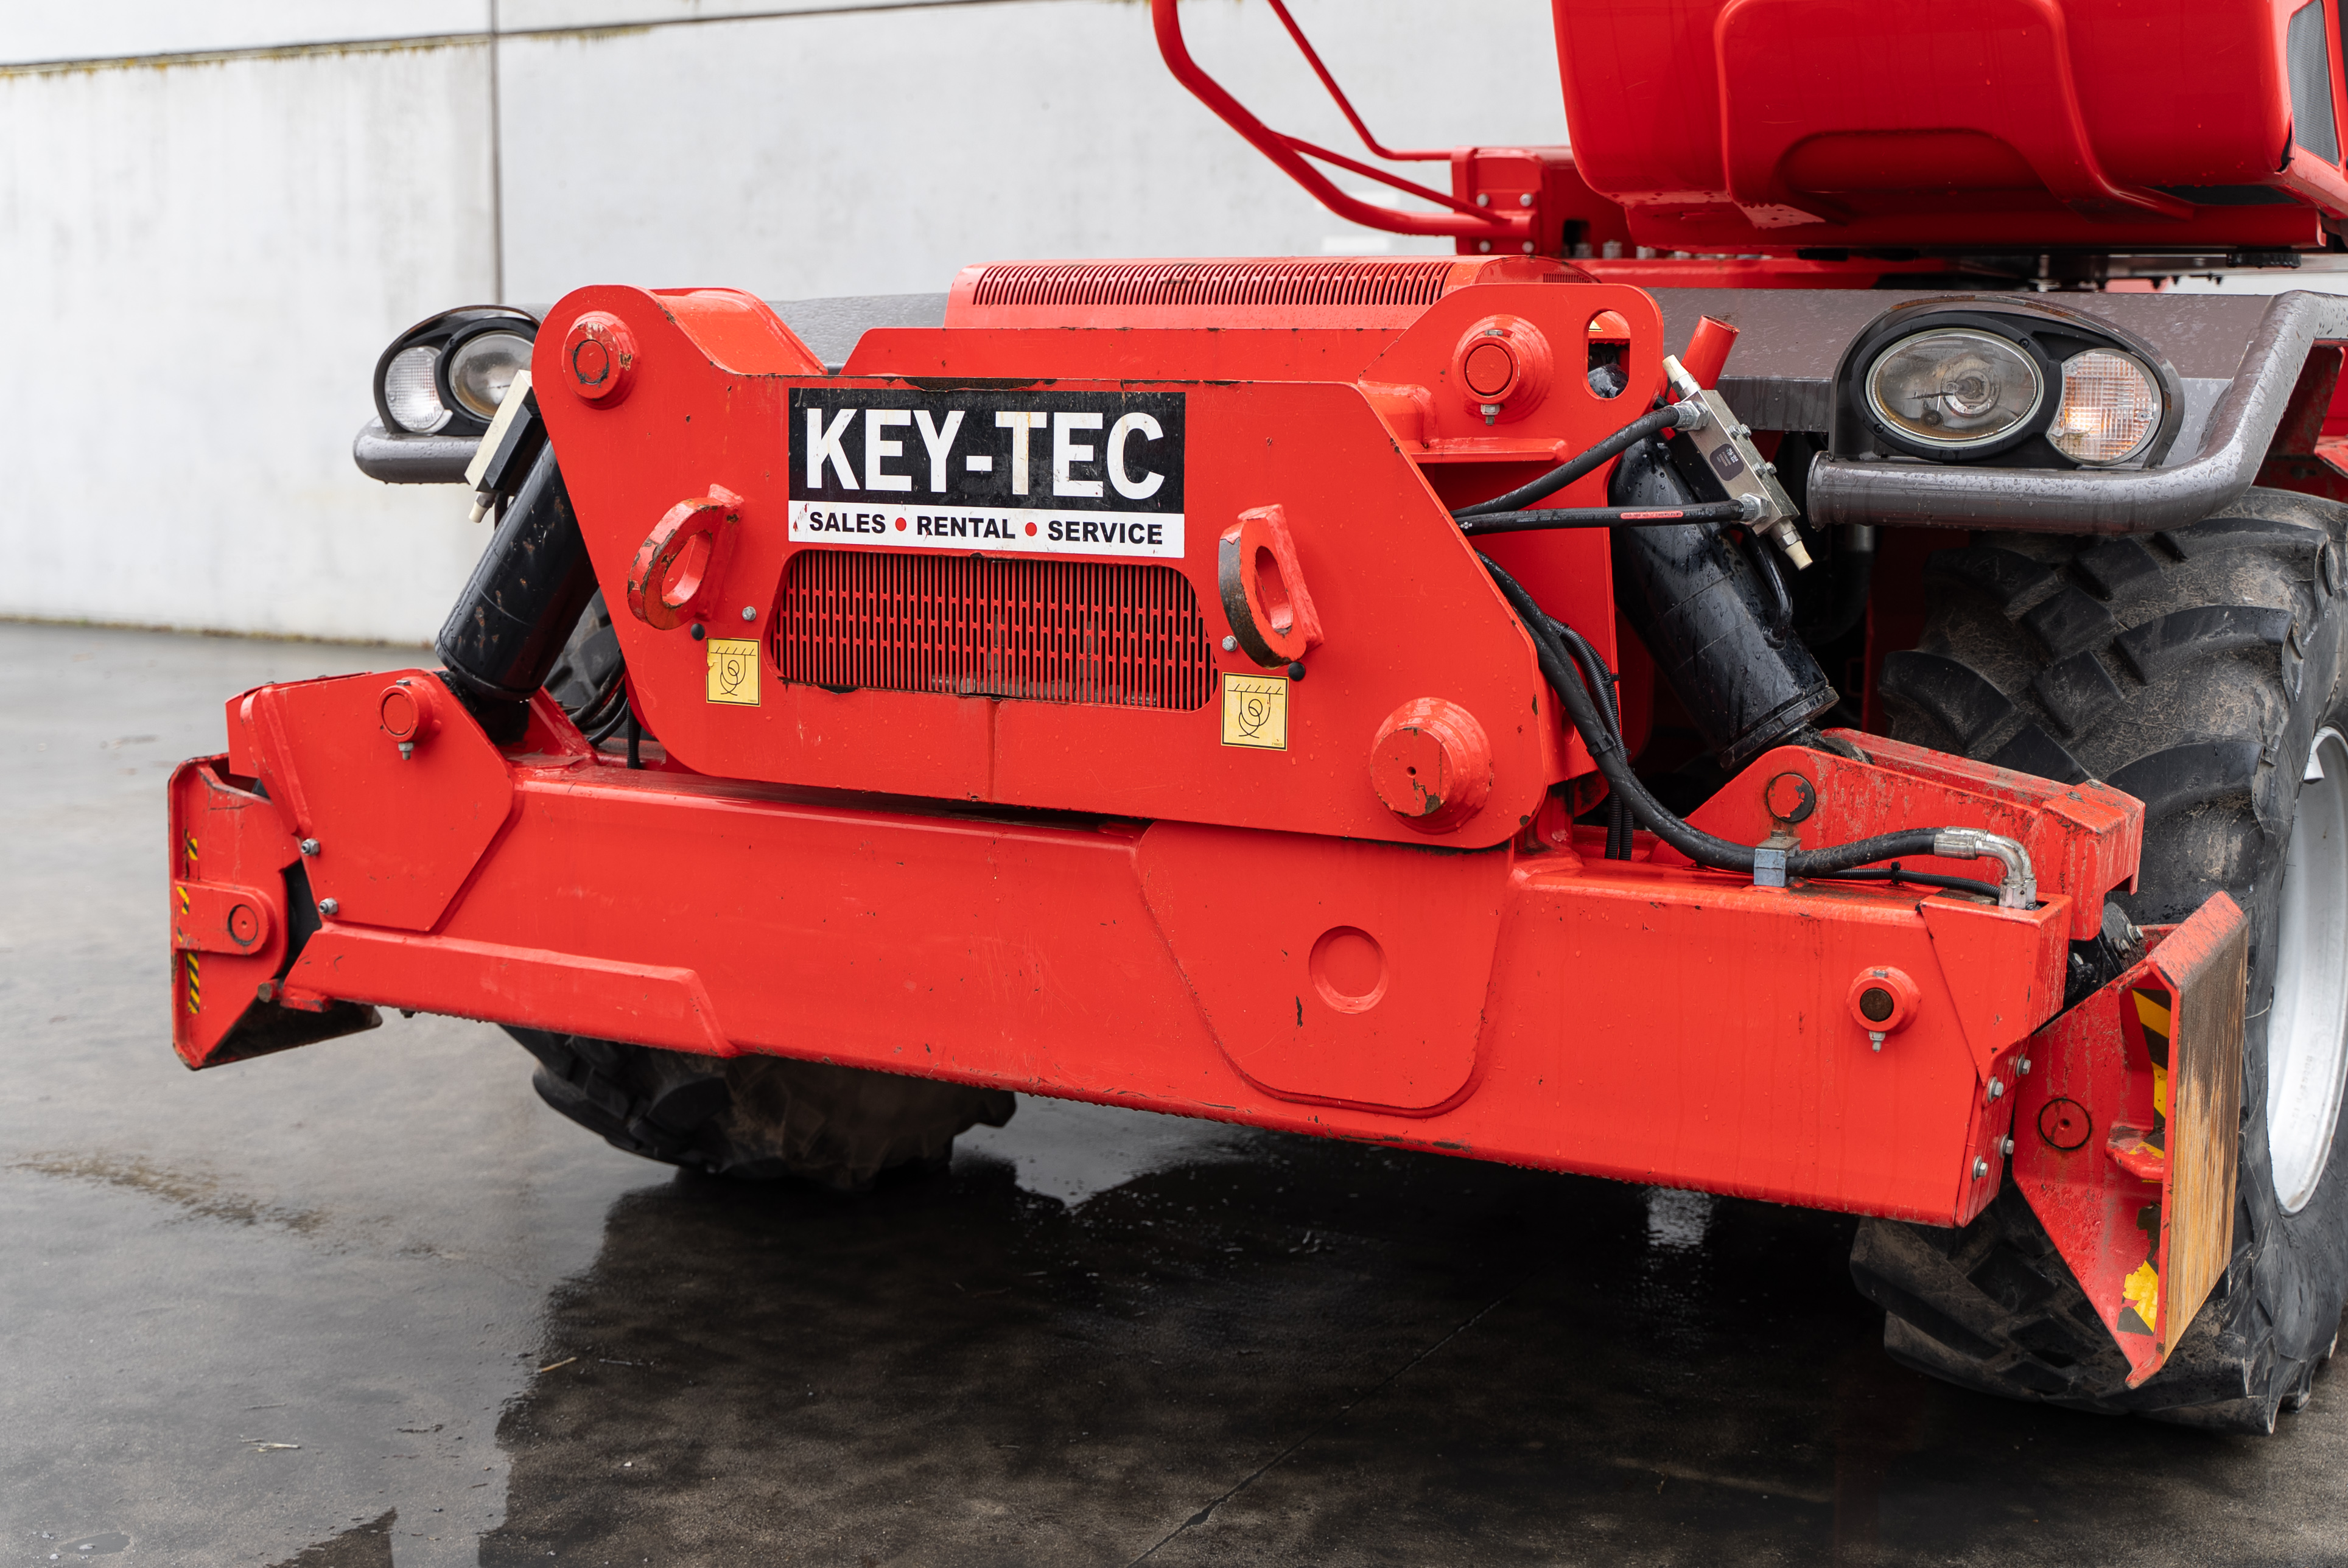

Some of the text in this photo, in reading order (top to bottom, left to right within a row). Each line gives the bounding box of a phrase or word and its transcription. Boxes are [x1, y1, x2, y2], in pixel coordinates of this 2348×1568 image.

[807, 408, 1165, 500] KEY-TEC
[809, 512, 1163, 545] SALES RENTAL SERVICE
